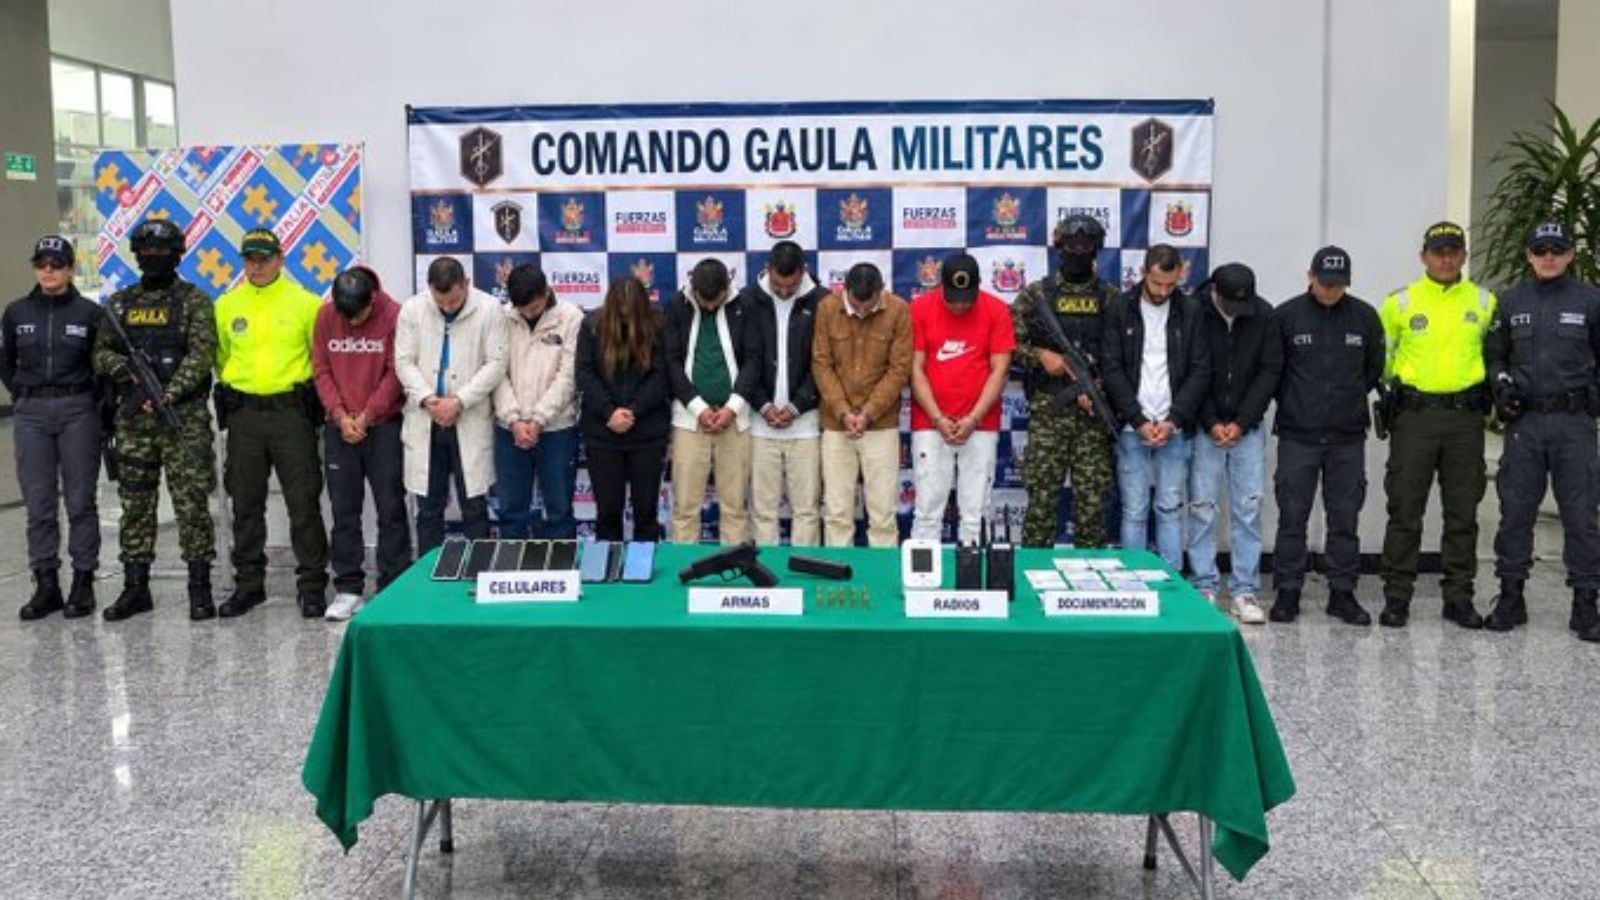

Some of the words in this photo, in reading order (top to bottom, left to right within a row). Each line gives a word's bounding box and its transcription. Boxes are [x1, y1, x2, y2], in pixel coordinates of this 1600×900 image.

[532, 128, 730, 175] COMANDO
[744, 127, 877, 172] GAULA
[892, 125, 1104, 170] MILITARES
[616, 211, 666, 224] FUERZAS
[903, 207, 956, 220] FUERZAS
[552, 271, 600, 284] FUERZAS
[128, 308, 168, 323] GAULA
[328, 338, 384, 353] adidas
[489, 580, 566, 594] CELULARES
[721, 591, 770, 608] ARMAS
[933, 598, 980, 611] RADIOS
